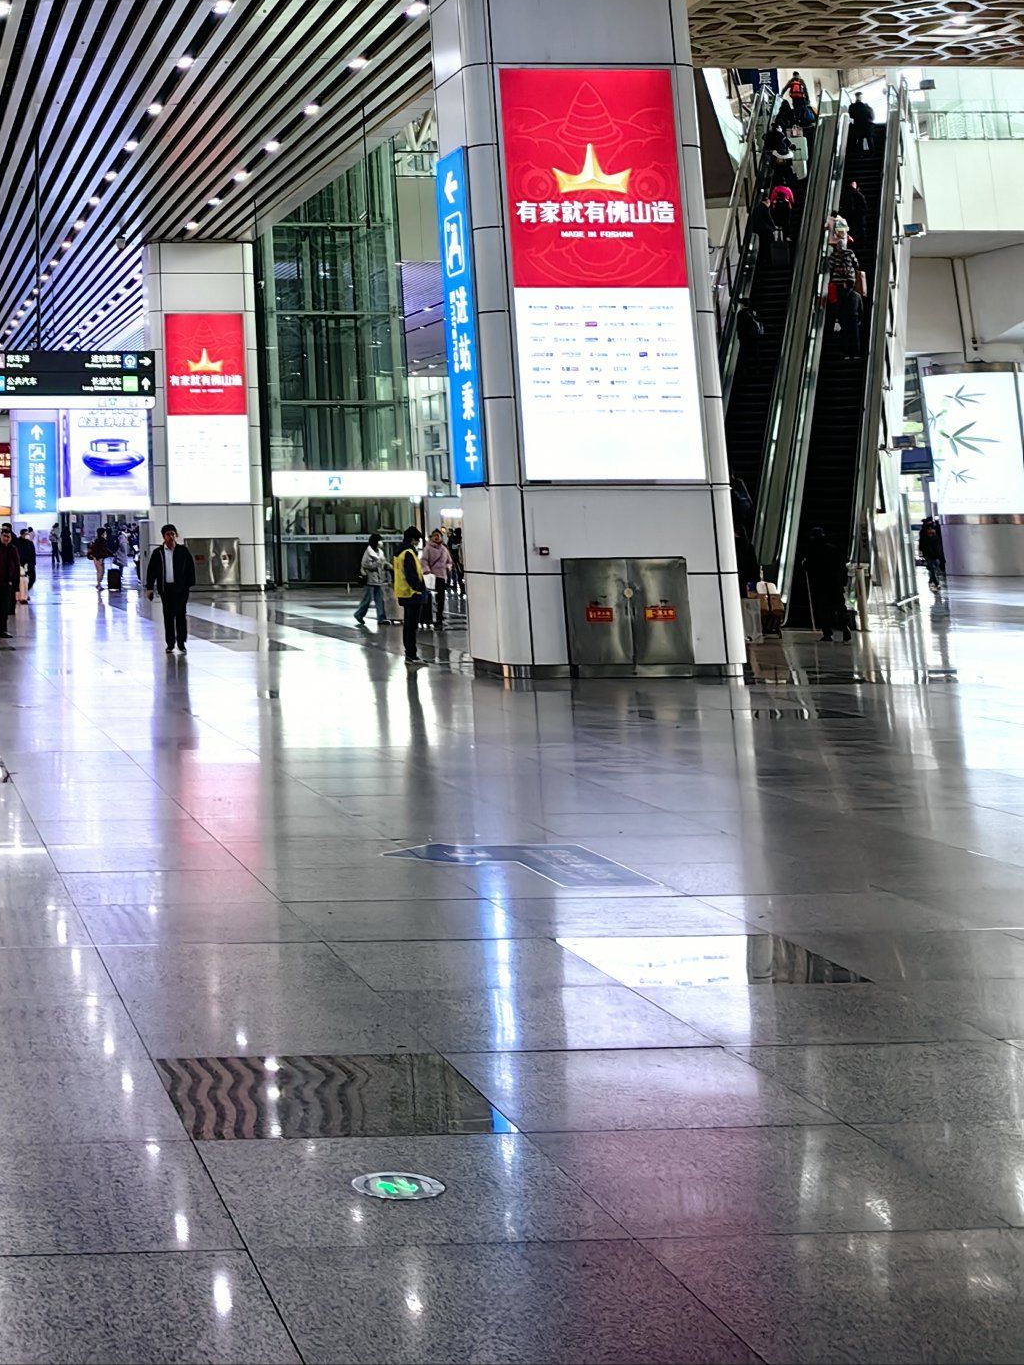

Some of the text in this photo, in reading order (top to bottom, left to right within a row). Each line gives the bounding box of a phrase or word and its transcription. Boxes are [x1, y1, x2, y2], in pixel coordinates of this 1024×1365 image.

[516, 200, 675, 224] 有家就有佛山造
[6, 354, 30, 363] 停车场
[7, 376, 37, 385] 公共汽车
[90, 377, 121, 386] 长途汽车
[455, 285, 478, 471] 进站乘车
